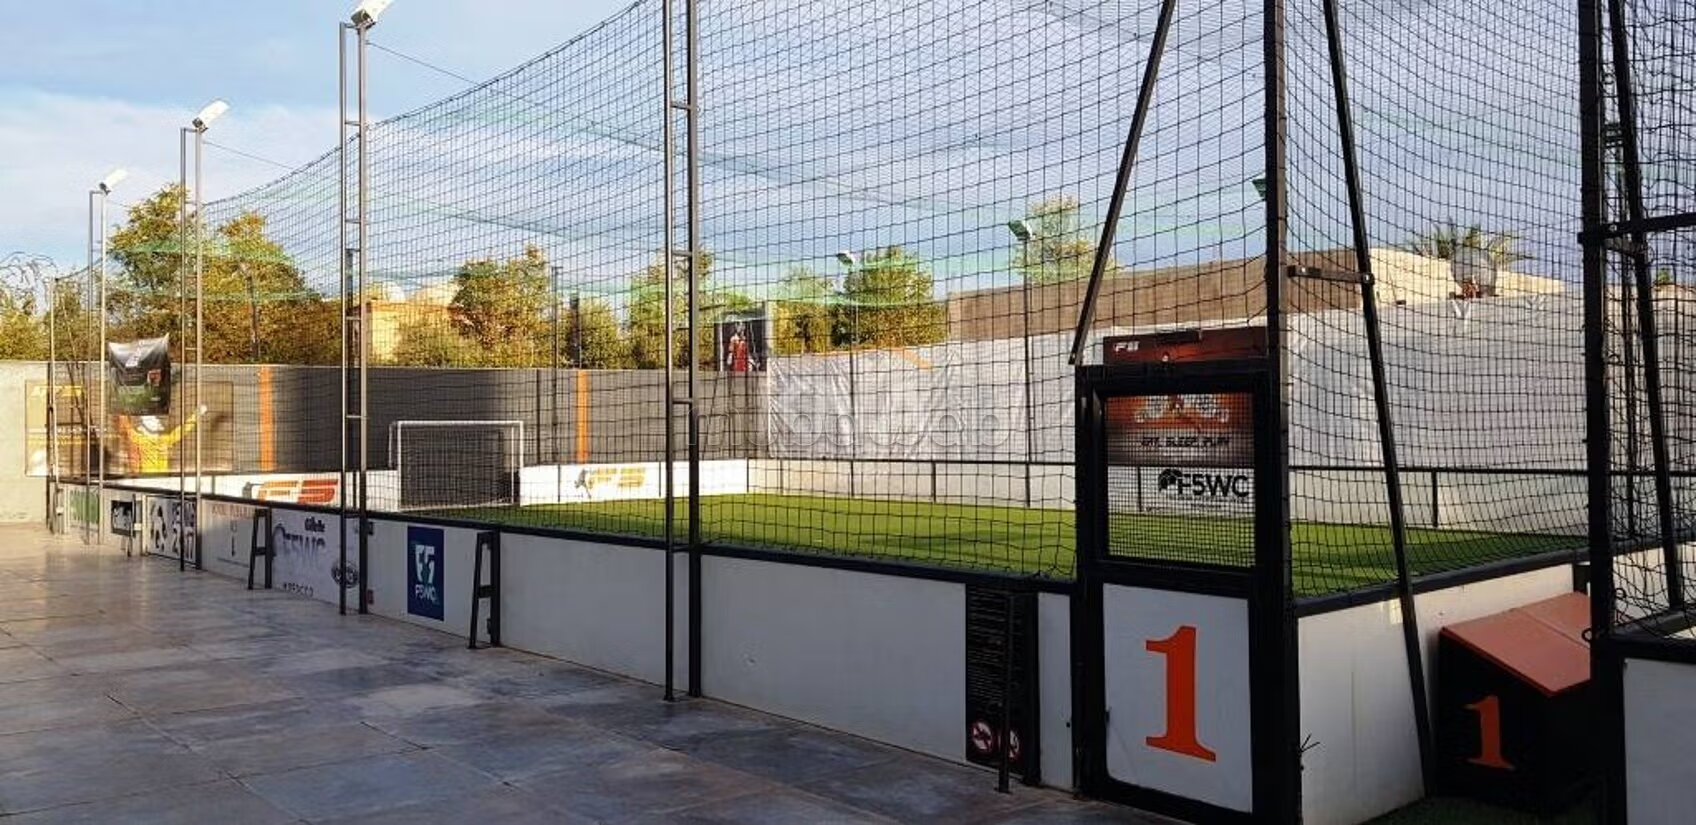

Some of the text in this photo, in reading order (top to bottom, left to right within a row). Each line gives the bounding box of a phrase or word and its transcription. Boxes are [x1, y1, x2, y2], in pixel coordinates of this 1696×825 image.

[1177, 473, 1250, 498] F5WC
[1145, 625, 1217, 762] 1
[1465, 695, 1514, 769] 1
